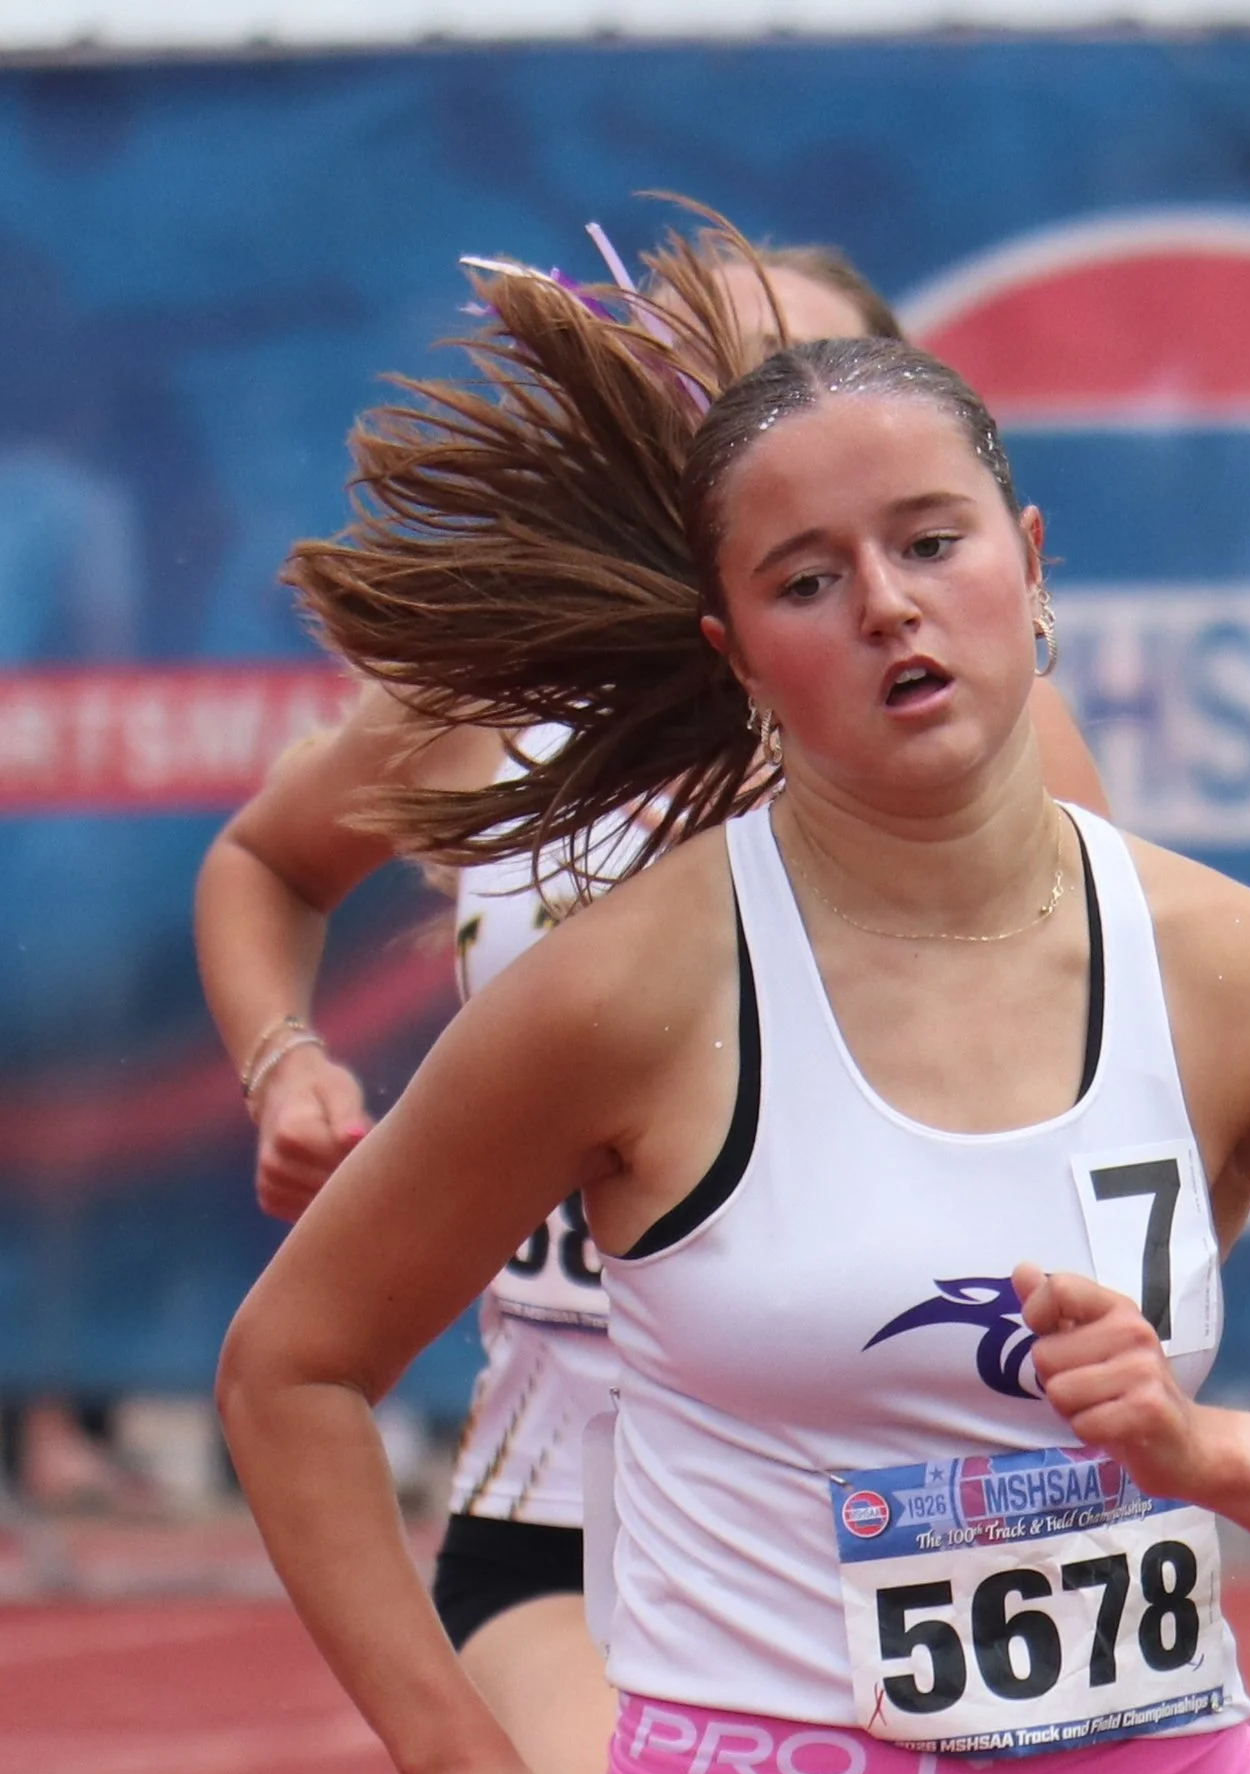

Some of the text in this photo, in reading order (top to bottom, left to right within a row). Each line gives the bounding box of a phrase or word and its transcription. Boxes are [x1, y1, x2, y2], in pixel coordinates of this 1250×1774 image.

[1089, 1158, 1181, 1341] 7
[906, 1494, 946, 1518] 1926
[984, 1465, 1100, 1514] MSHSAA
[916, 1527, 942, 1549] The
[985, 1518, 1026, 1541] Track
[1029, 1518, 1042, 1535] &
[1046, 1509, 1074, 1532] Field
[876, 1540, 1200, 1714] 5678
[940, 1732, 1014, 1753] MSHSAA
[1016, 1724, 1060, 1746] Track
[1062, 1722, 1090, 1741] and
[1090, 1715, 1120, 1733] Field
[1121, 1695, 1208, 1725] Championships
